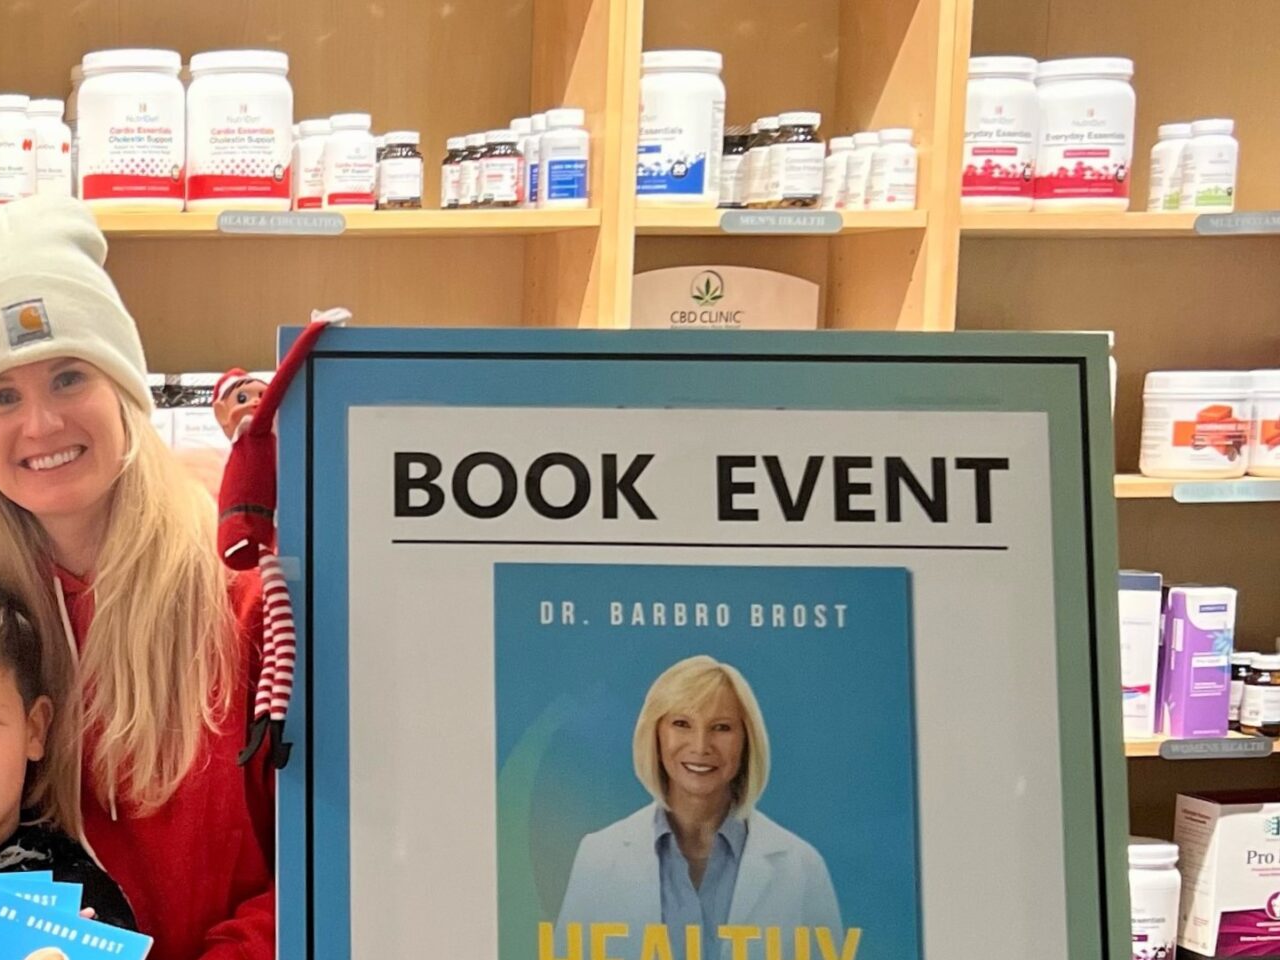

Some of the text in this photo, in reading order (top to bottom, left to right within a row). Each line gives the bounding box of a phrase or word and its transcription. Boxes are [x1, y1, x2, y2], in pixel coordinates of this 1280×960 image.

[147, 136, 173, 144] Support
[247, 137, 275, 145] Support
[1045, 132, 1084, 142] Everyday
[670, 310, 742, 324] CBD CLINIC
[393, 451, 1010, 524] BOOK EVENT
[540, 601, 849, 628] DR. BARBRO BROST
[1246, 850, 1274, 865] Pro
[26, 915, 78, 941] BARBRO
[81, 932, 124, 954] BROST
